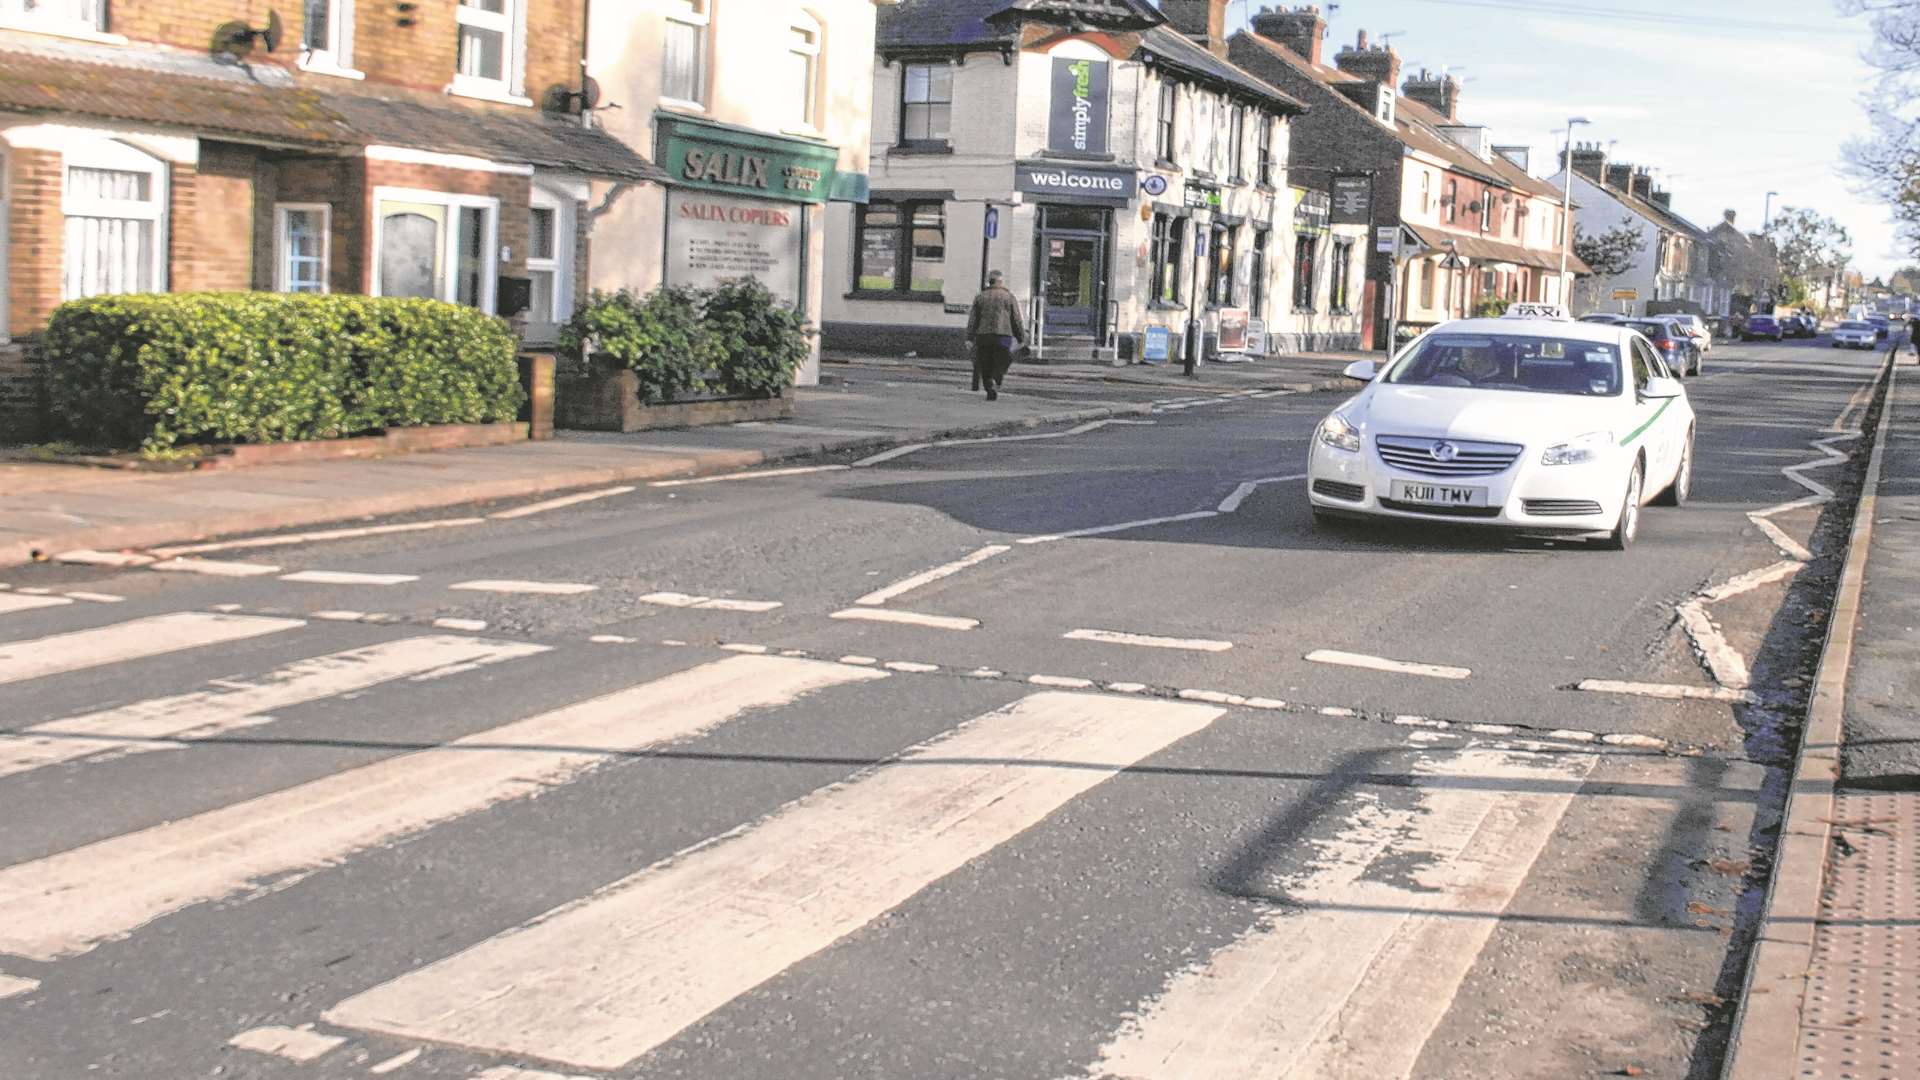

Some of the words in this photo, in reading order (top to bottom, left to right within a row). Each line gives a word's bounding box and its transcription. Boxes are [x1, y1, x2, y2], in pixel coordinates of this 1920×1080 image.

[684, 149, 770, 188] SALIX
[1031, 171, 1123, 190] welcome
[680, 203, 725, 222] SALIX
[729, 206, 789, 226] COPIERS
[1516, 306, 1561, 317] TAXI
[1404, 485, 1435, 501] KU11
[1440, 487, 1473, 503] TMV
